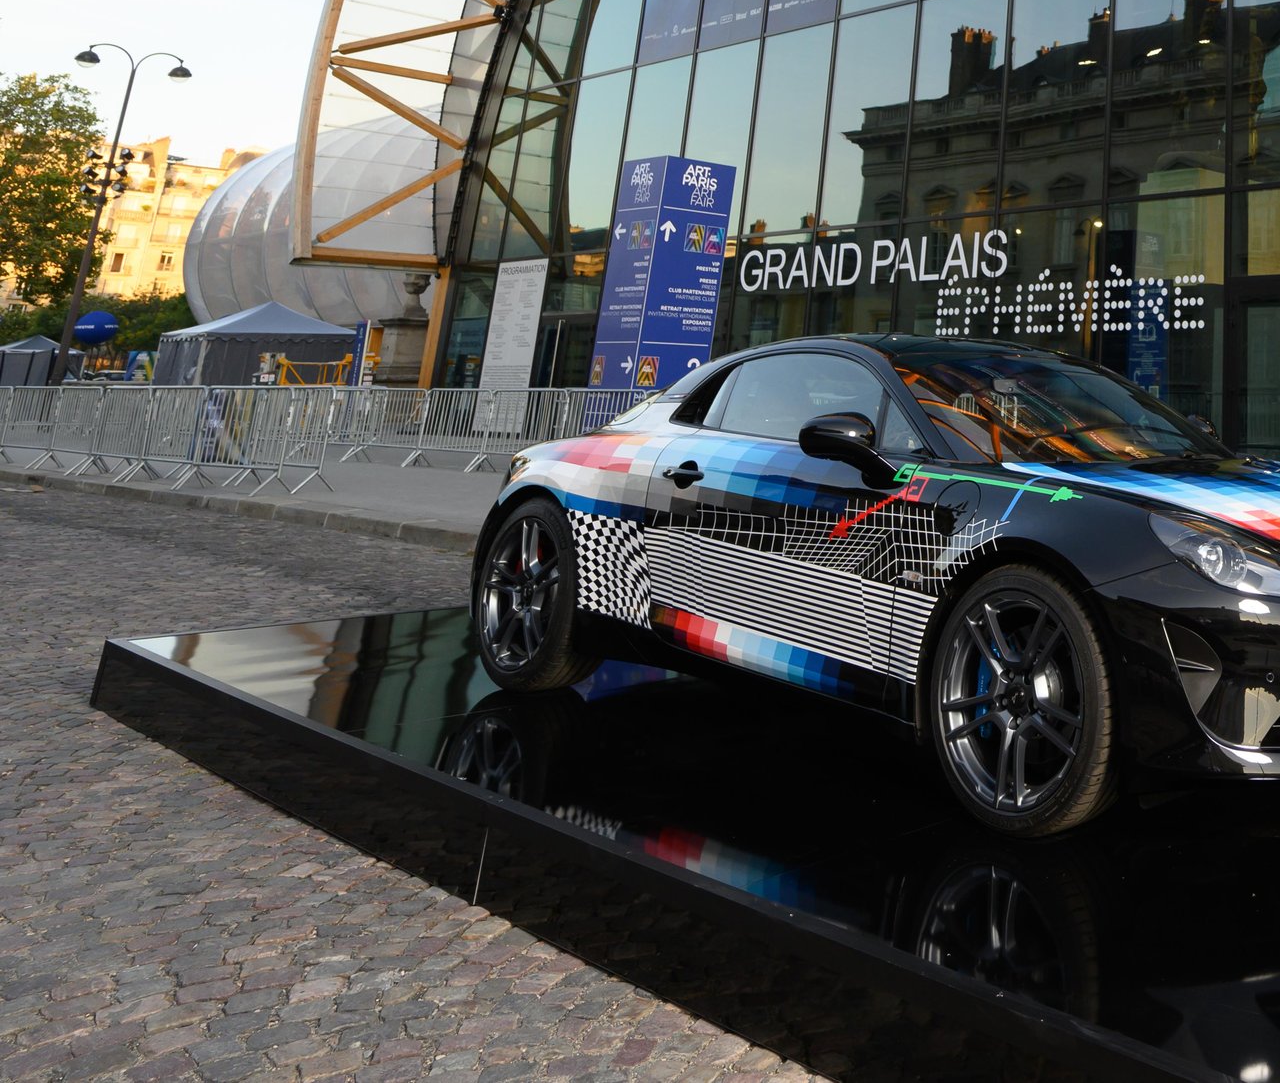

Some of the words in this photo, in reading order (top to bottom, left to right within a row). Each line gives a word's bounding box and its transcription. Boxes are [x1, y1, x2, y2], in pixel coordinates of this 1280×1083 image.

[631, 173, 653, 186] PARIS
[682, 174, 717, 191] PARIS
[637, 185, 650, 193] ART
[692, 187, 715, 199] ART
[634, 193, 650, 203] FAIR
[690, 196, 714, 208] FAIR
[740, 242, 862, 292] GRAND
[871, 229, 1008, 284] PALAIS
[501, 264, 546, 275] PROGRAMMATION
[935, 264, 1205, 336] ÉPHÉMÈRE
